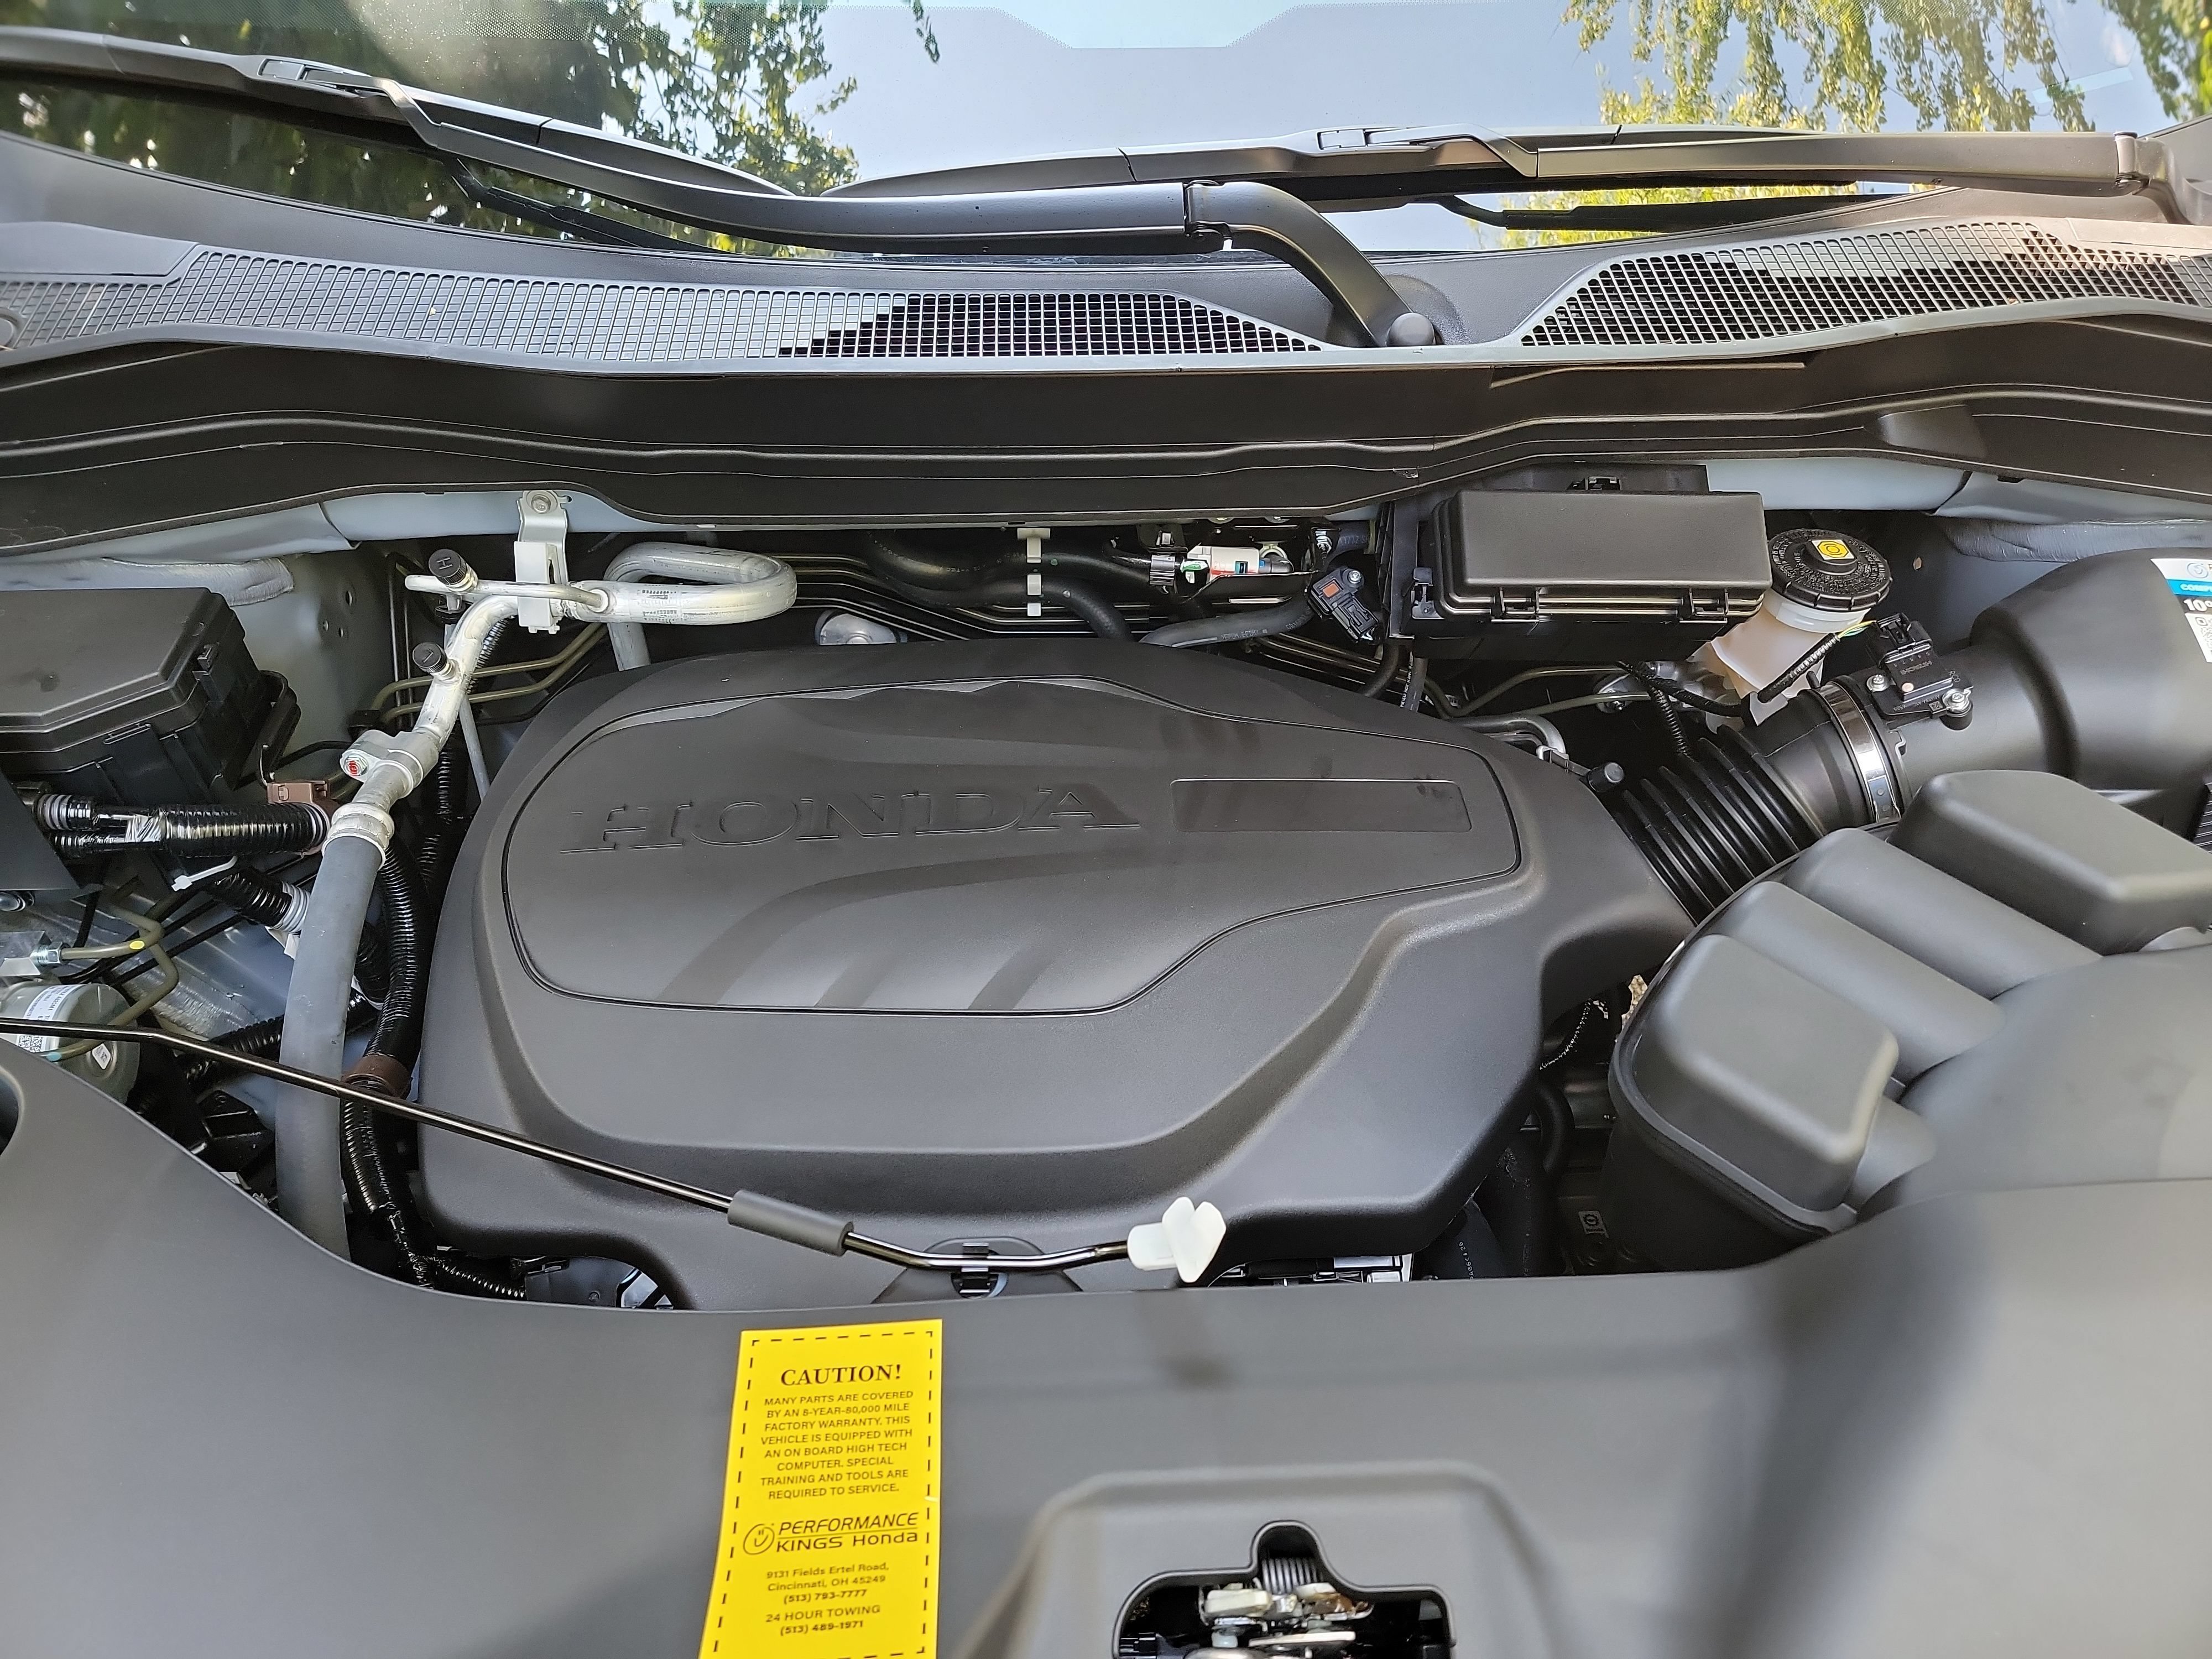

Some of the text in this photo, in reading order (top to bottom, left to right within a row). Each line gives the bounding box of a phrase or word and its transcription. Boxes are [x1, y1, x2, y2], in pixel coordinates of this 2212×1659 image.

[437, 557, 452, 570] H
[560, 784, 1140, 854] HONDA
[780, 1364, 901, 1386] CAUTION!
[764, 1397, 796, 1406] MANY
[800, 1395, 834, 1404] PARTS
[862, 1391, 914, 1401] COVERED
[766, 1410, 781, 1418] BY
[884, 1403, 910, 1412] MILE
[765, 1416, 911, 1432] FACTORY WARRANTY. THIS
[760, 1429, 913, 1446] VEHICLE IS EQUIPPED WITH
[764, 1442, 907, 1458] AN ON BOARD HIGH TECH
[777, 1456, 894, 1471] COMPUTER. SPECIAL
[760, 1469, 909, 1486] TRAINING AND TOOLS ARE
[768, 1483, 900, 1500] REQUIRED TO SERVICE.
[779, 1512, 919, 1536] PERFORMANCE
[776, 1532, 918, 1553] KINGS Honda
[766, 1570, 789, 1579] 9131
[792, 1567, 826, 1577] Fields
[829, 1564, 855, 1574] Ertel
[768, 1579, 827, 1592] Cincinnati,
[831, 1577, 848, 1587] OH
[784, 1594, 811, 1605] (513)
[765, 1605, 881, 1623] 24 HOUR TOWING
[780, 1625, 808, 1636] (513)
